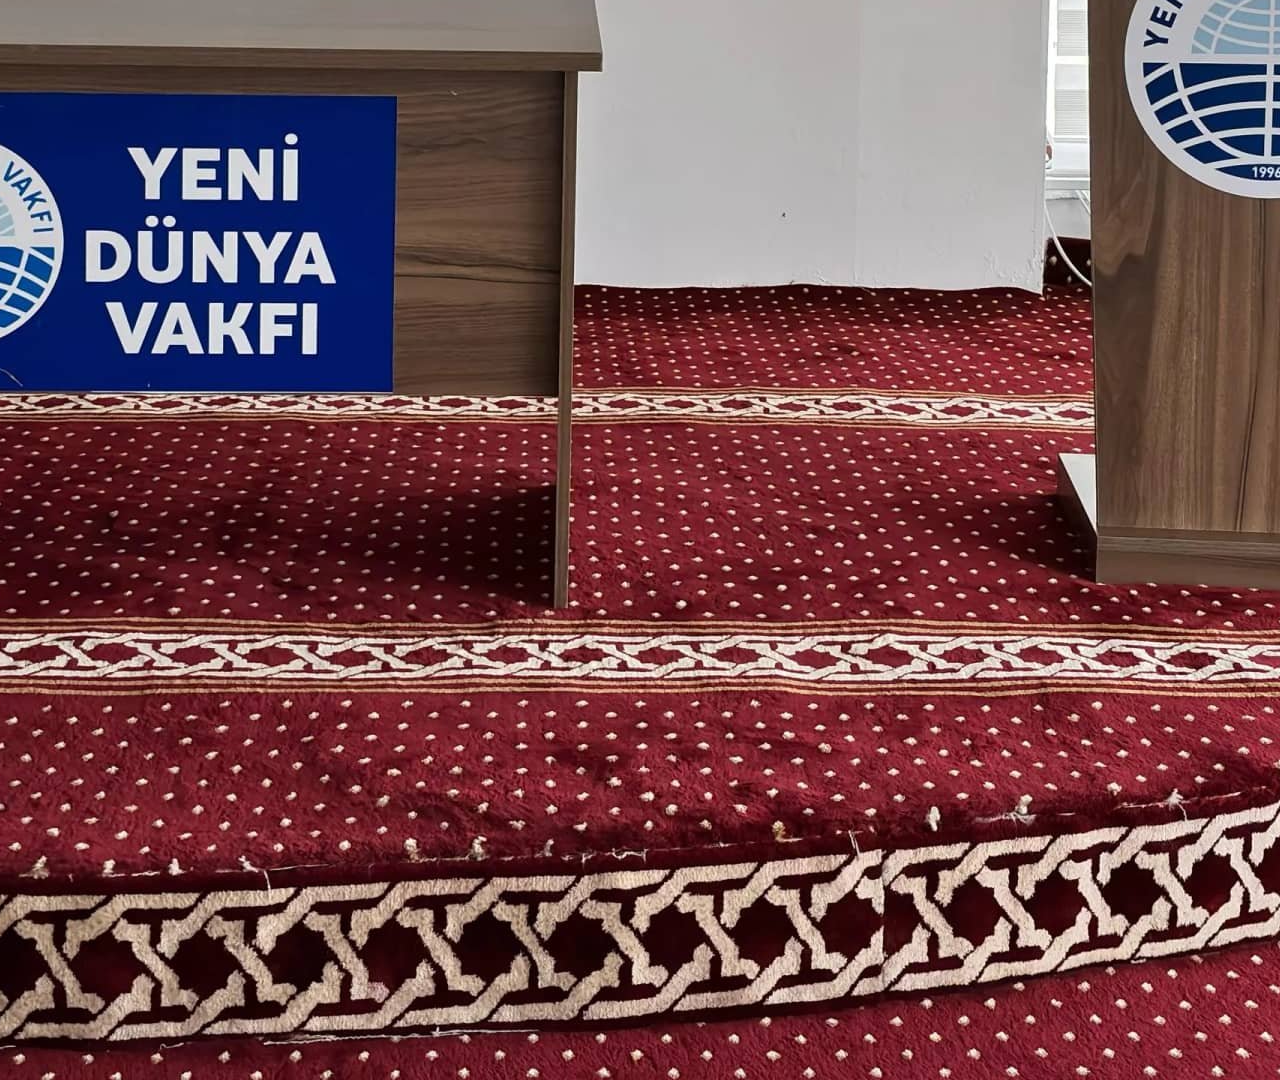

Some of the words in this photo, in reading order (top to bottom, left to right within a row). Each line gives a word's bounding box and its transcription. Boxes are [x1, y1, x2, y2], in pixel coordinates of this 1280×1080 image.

[1, 160, 55, 233] VAKFI
[127, 132, 300, 201] YENİ
[84, 215, 337, 285] DÜNYA
[104, 301, 319, 355] VAKFI
